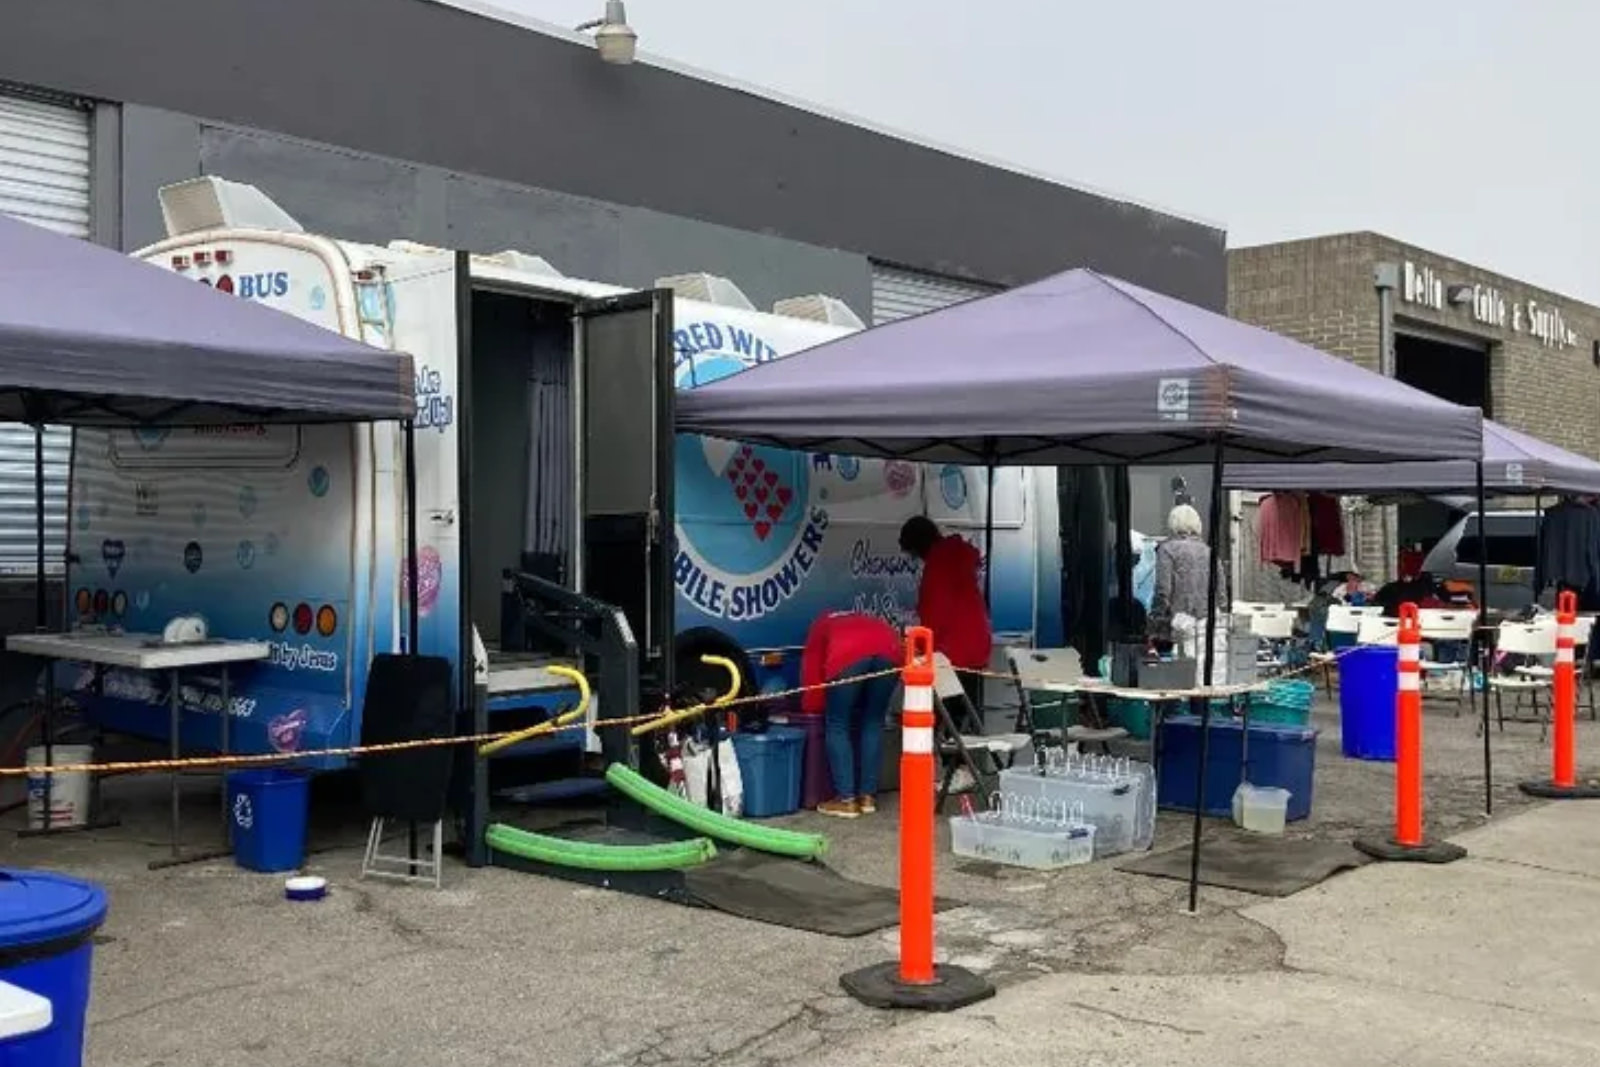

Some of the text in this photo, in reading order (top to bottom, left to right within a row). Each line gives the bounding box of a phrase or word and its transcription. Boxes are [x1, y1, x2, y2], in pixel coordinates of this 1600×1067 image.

[238, 271, 289, 298] BUS
[726, 324, 779, 365] WIT
[673, 504, 830, 620] BILE SHOWERS
